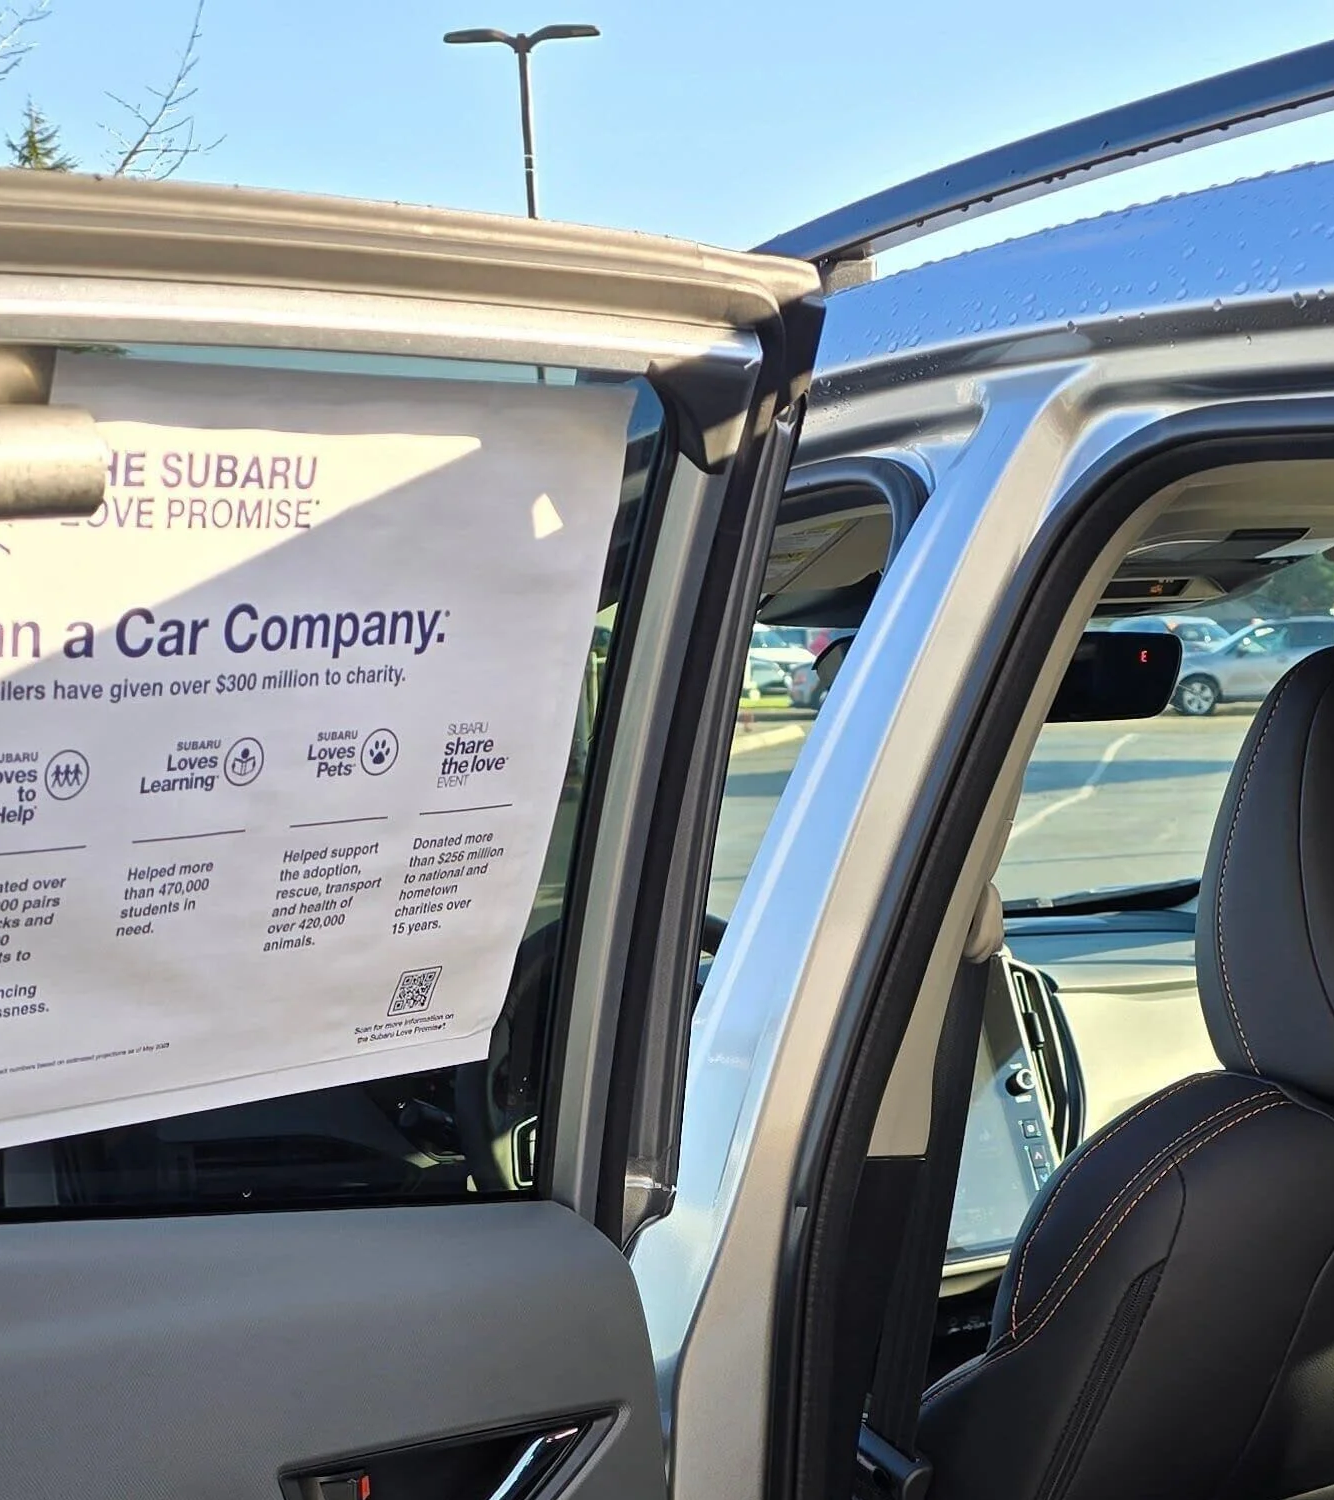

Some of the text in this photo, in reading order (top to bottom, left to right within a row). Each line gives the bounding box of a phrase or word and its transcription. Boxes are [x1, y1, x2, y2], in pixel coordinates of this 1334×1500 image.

[161, 452, 317, 490] SUBARU
[61, 498, 155, 529] OVE
[63, 620, 95, 658] a
[116, 608, 209, 658] Car
[50, 680, 103, 700] have
[110, 679, 163, 703] given
[170, 678, 210, 696] over
[216, 672, 257, 695] $300
[262, 670, 319, 690] million
[325, 668, 341, 686] to
[347, 664, 405, 684] charity.
[317, 730, 358, 742] SUBARU
[447, 722, 488, 736] SUBARU
[176, 740, 221, 751] SUBARU
[307, 745, 355, 760] Loves
[445, 738, 494, 756] share
[167, 754, 218, 772] Loves
[317, 762, 352, 777] Pets
[441, 755, 506, 775] the love
[140, 773, 215, 794] Learning
[437, 775, 469, 788] EVENT
[18, 786, 36, 802] to
[413, 832, 493, 850] Donated more
[283, 842, 378, 864] Helped support
[409, 846, 504, 867] than $256 million
[127, 861, 214, 881] Helped more
[280, 863, 362, 881] the adoption,
[404, 864, 488, 884] to national and
[33, 877, 66, 890] over
[124, 878, 209, 900] than 470,000
[276, 877, 382, 900] rescue, transport
[399, 884, 457, 900] hometown
[22, 895, 60, 912] pairs
[120, 899, 195, 919] students in
[272, 896, 353, 917] and health of
[395, 899, 471, 917] charities over
[25, 913, 54, 927] and
[267, 914, 345, 935] over 420,000
[392, 920, 441, 935] 15 years.
[116, 922, 154, 937] need.
[263, 935, 315, 952] animals.
[16, 950, 31, 962] to
[355, 1025, 372, 1034] Scan
[370, 1032, 394, 1041] Subaru
[396, 1028, 412, 1037] Love
